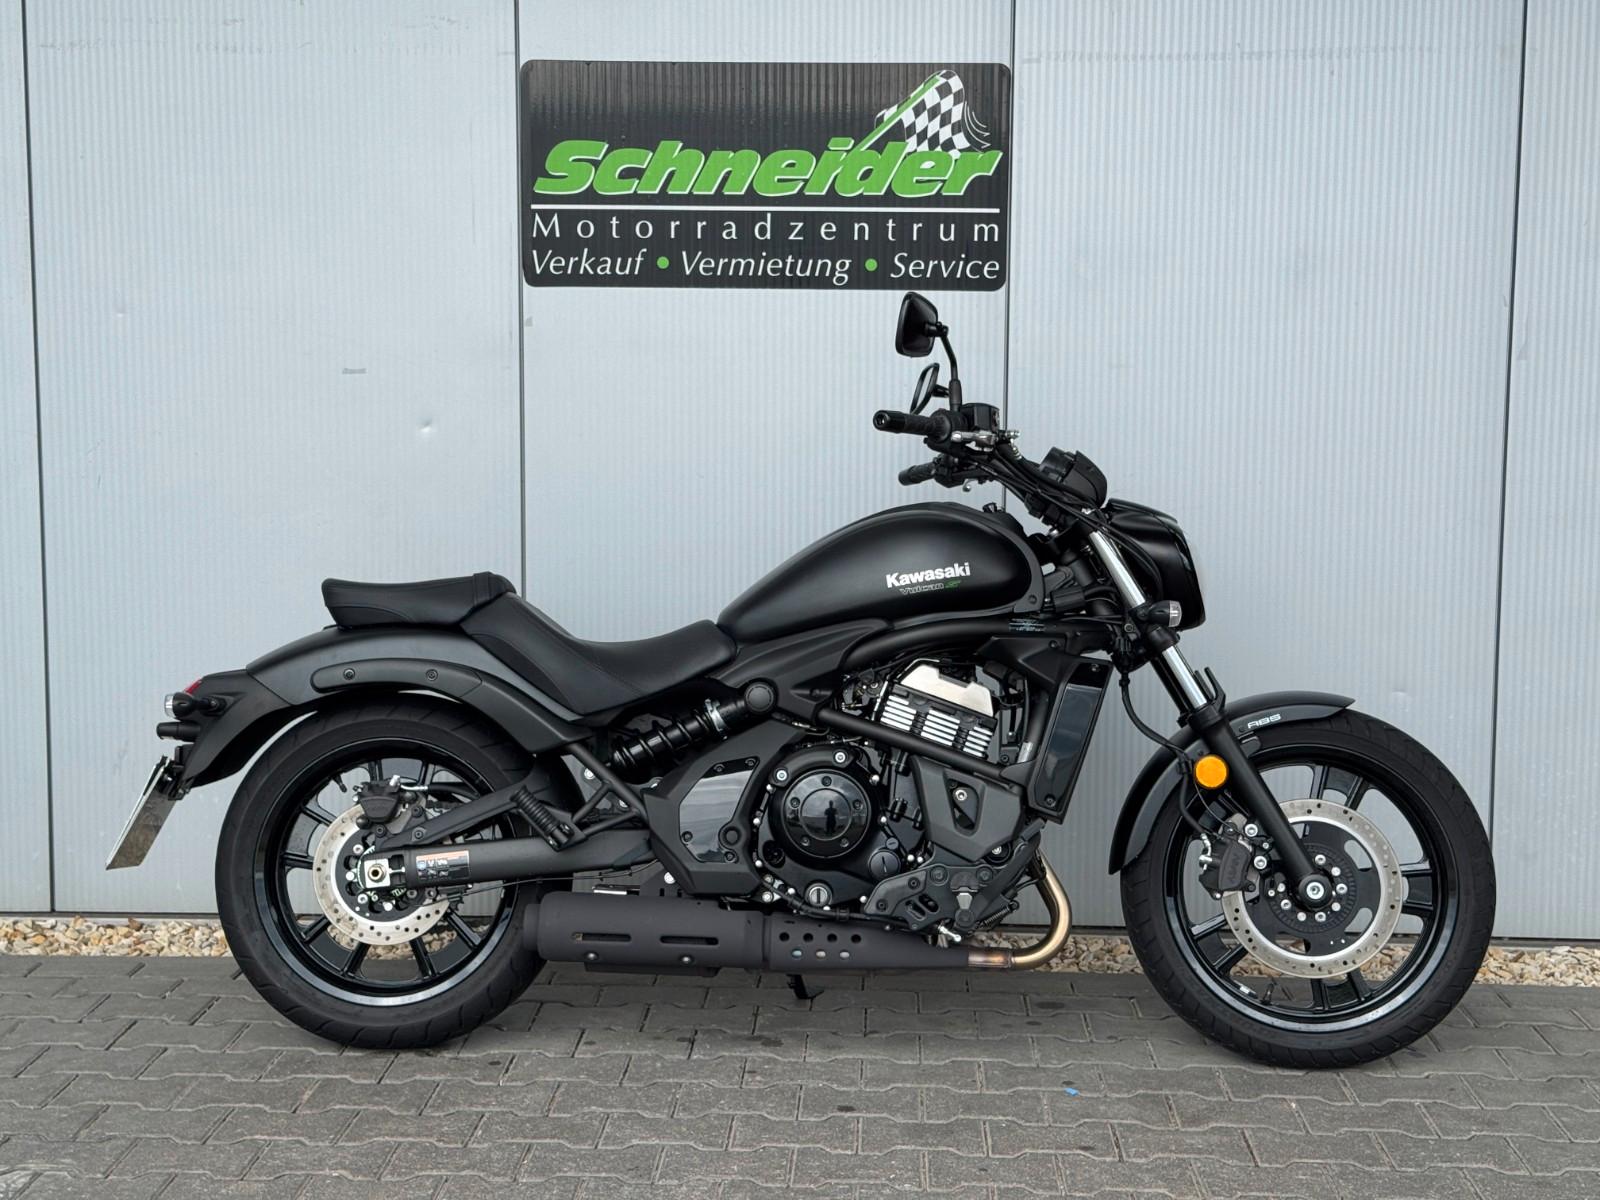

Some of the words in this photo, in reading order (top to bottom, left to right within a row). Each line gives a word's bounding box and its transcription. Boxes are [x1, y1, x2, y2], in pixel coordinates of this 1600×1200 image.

[533, 137, 1003, 197] Schneider
[532, 213, 999, 242] Motorradzentrum
[532, 248, 647, 275] Verkauf
[682, 251, 852, 286] Vermietung
[890, 252, 1000, 279] Service
[885, 562, 971, 588] Kawasaki
[1247, 713, 1281, 729] ABS
